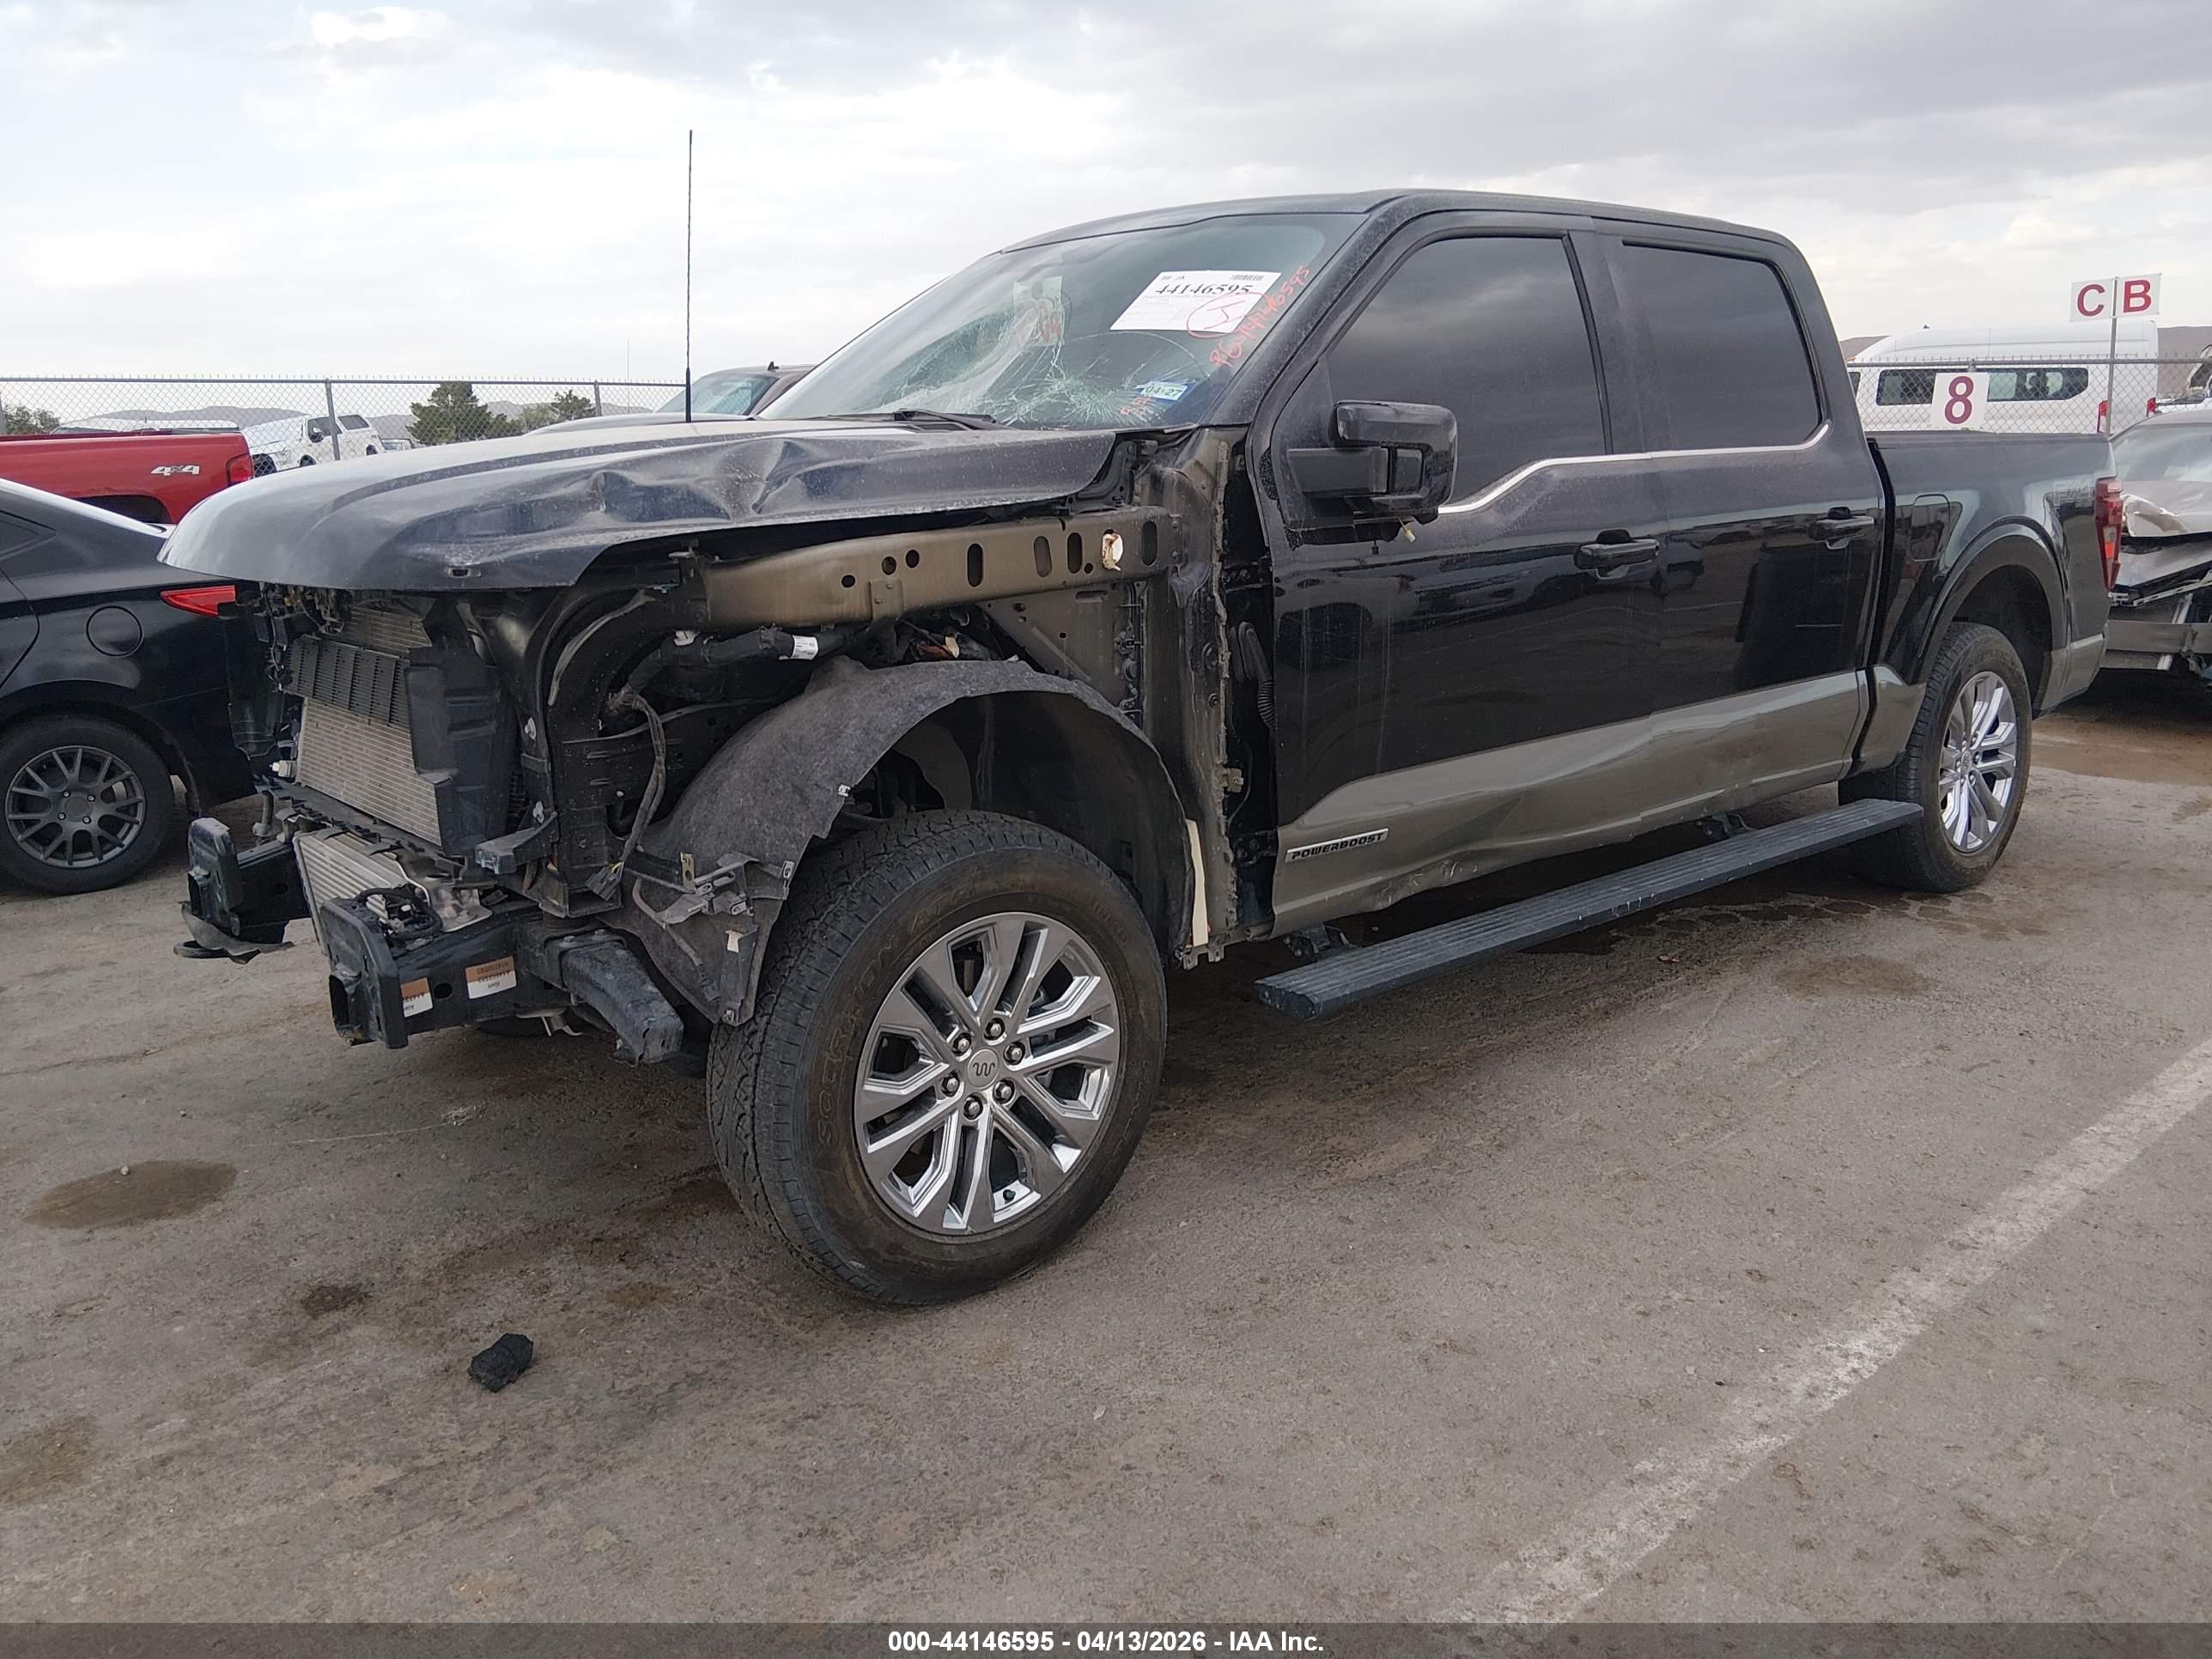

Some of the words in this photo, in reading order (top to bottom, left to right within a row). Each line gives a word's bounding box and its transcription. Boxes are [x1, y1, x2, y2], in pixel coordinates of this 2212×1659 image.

[1156, 283, 1255, 295] 44146595
[2076, 283, 2106, 317] C
[2123, 279, 2153, 313] B
[1944, 375, 1974, 424] 8
[1291, 832, 1385, 860] POWERBOOST
